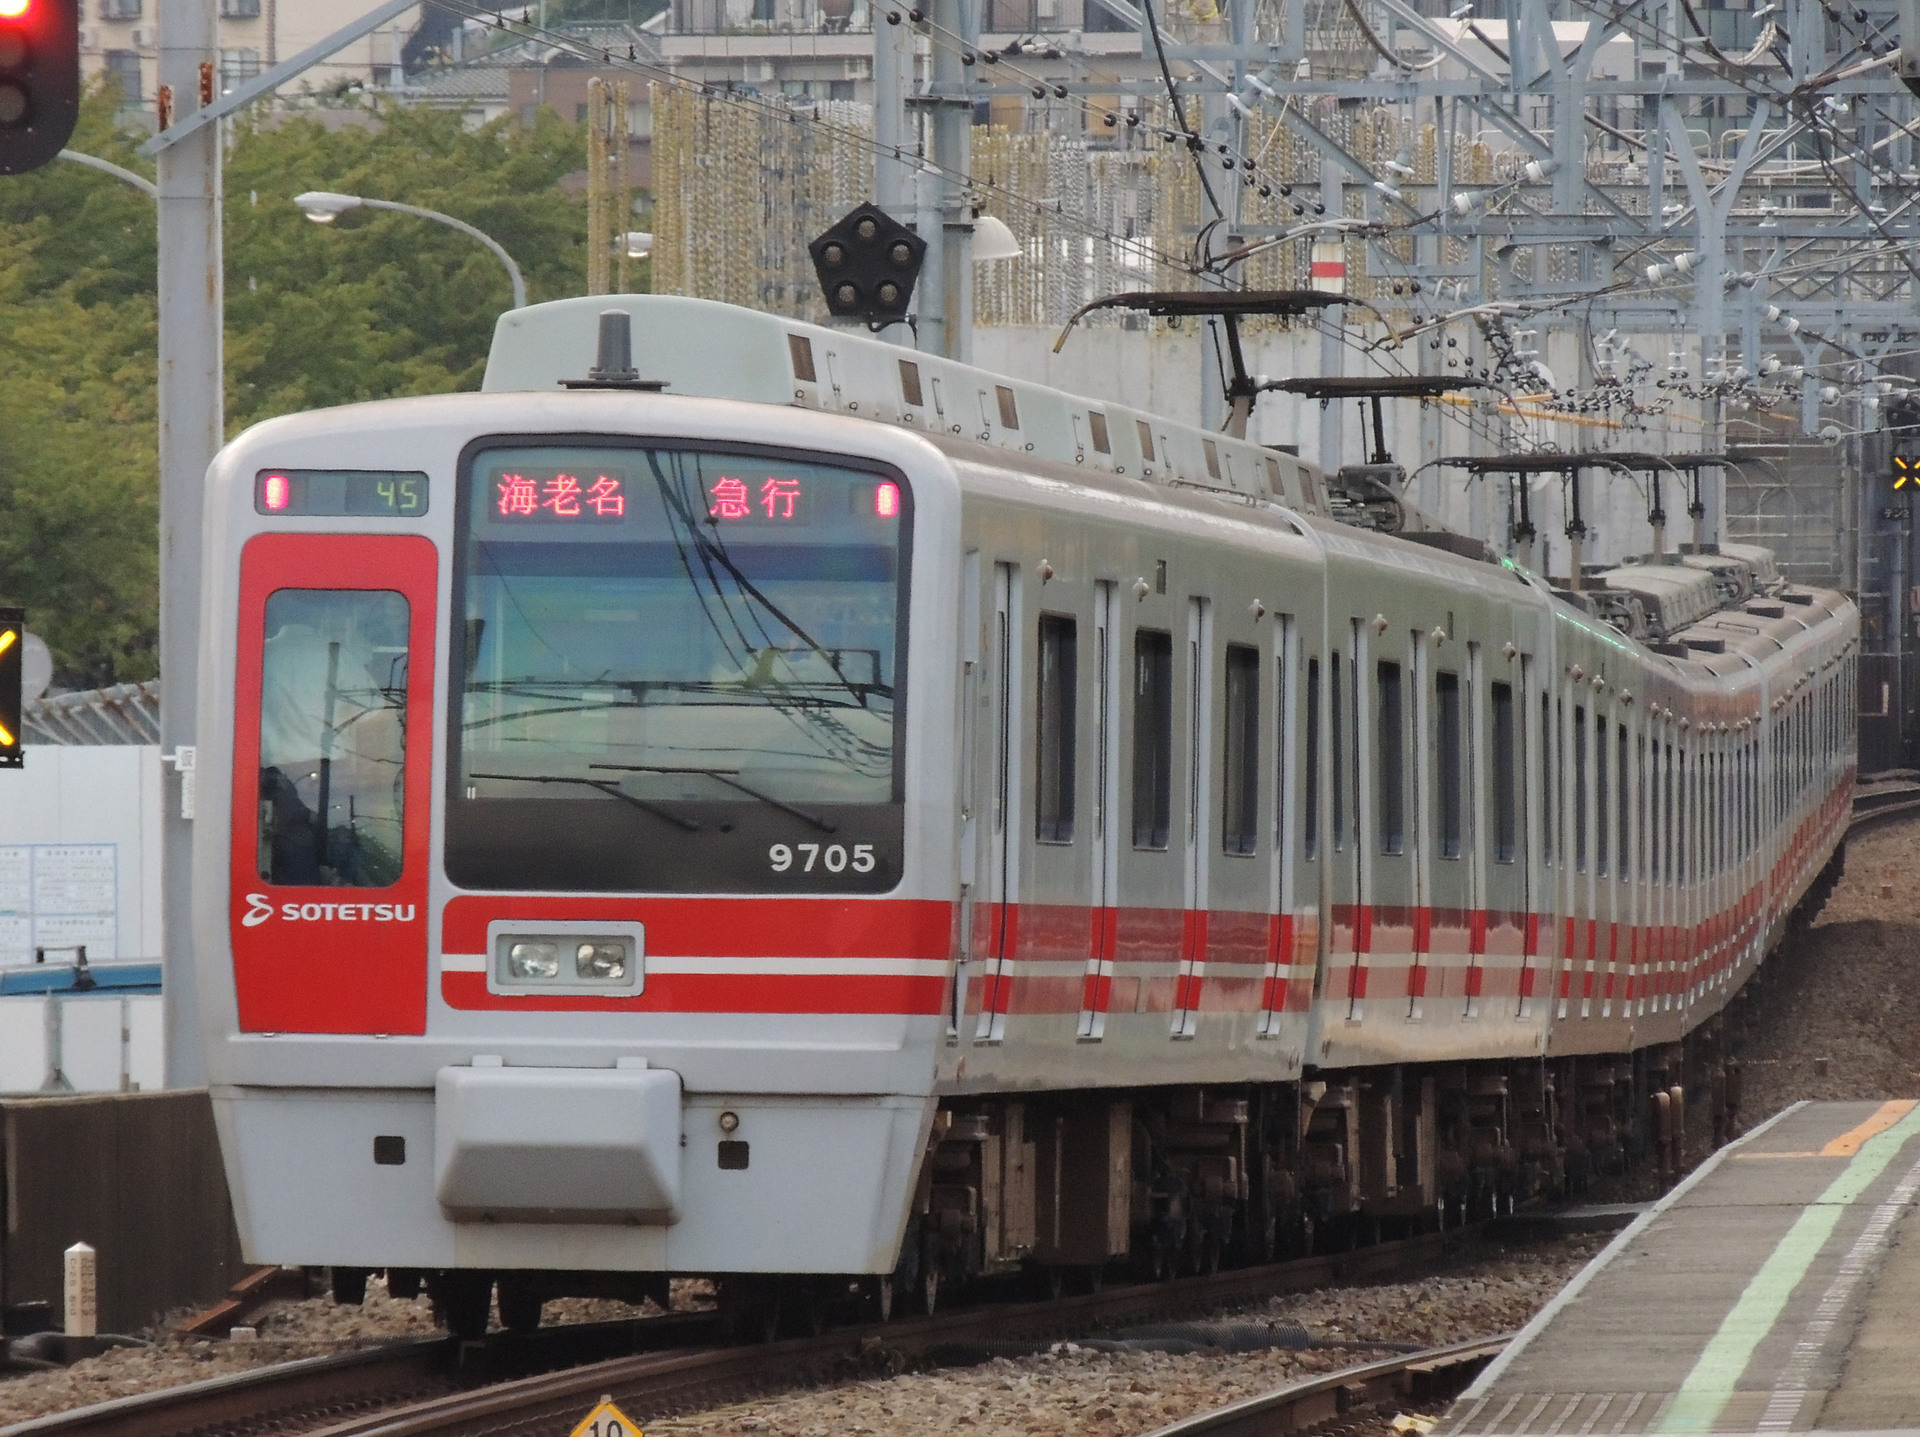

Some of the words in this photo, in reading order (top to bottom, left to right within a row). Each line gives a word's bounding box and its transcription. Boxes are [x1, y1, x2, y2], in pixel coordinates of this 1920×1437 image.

[377, 480, 418, 508] 45
[497, 474, 625, 515] 海老名
[710, 477, 800, 518] 急行
[769, 844, 875, 872] 9705
[281, 903, 416, 922] SOTETSU
[590, 1420, 623, 1437] 10
